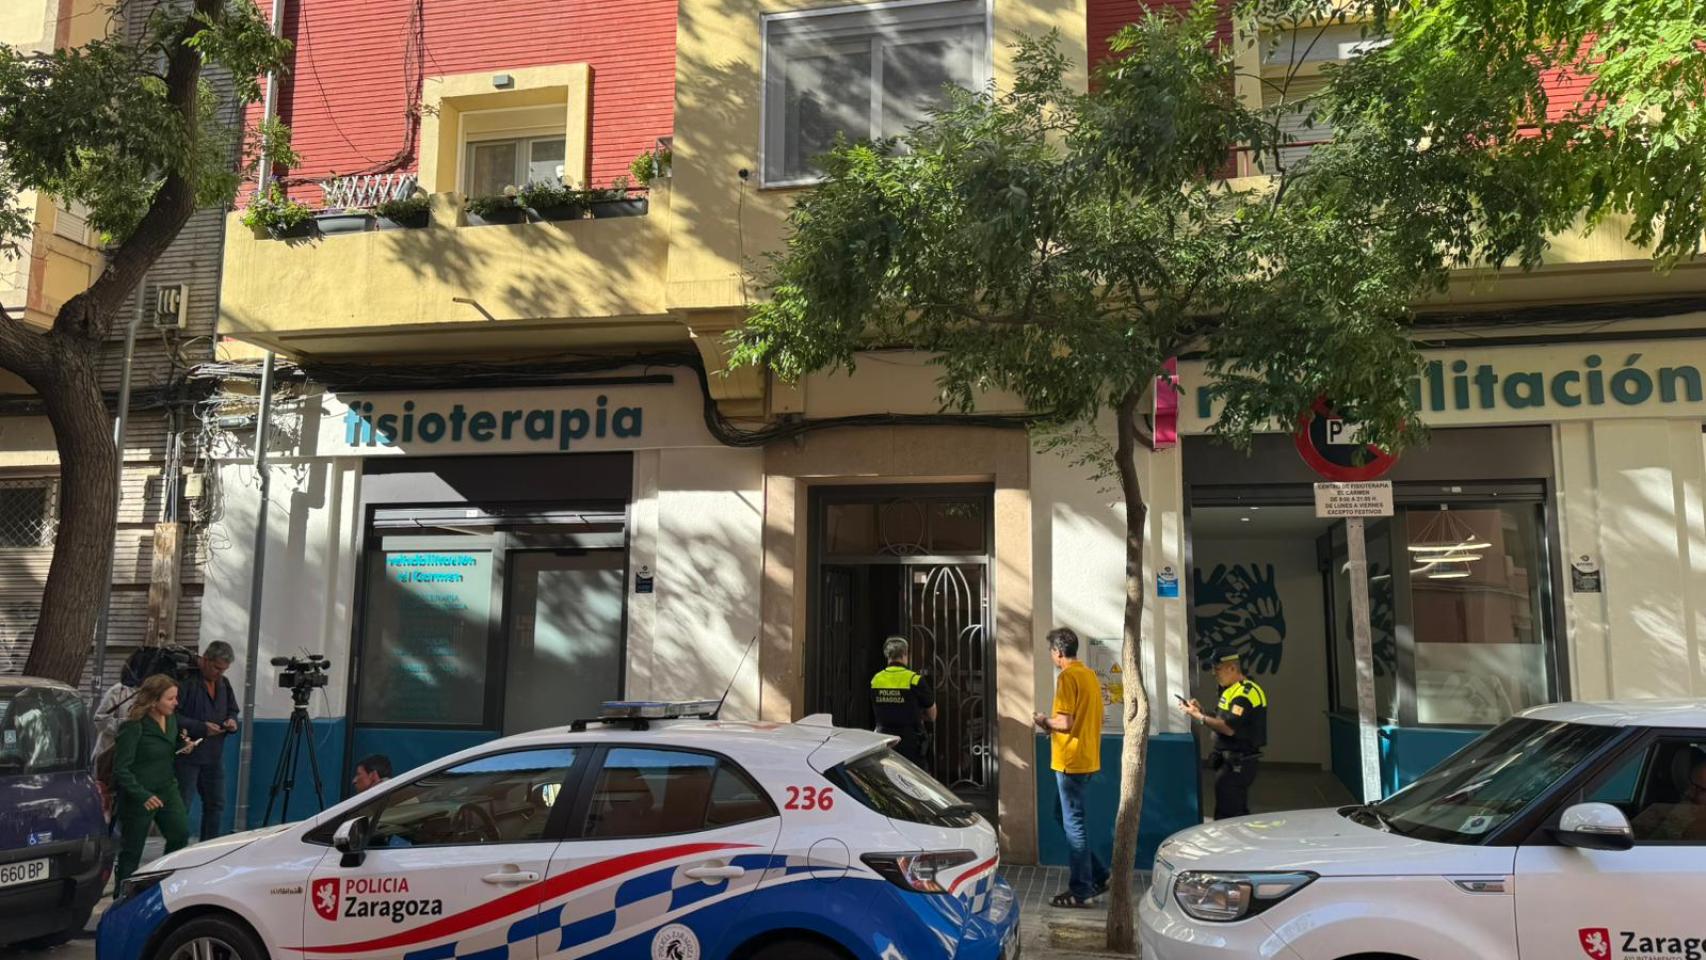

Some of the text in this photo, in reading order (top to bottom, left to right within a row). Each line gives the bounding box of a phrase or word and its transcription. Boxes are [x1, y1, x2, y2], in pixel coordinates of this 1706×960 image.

[344, 394, 643, 450] fisioterapia
[1330, 420, 1343, 442] P
[389, 552, 476, 567] rehabilitación
[414, 571, 463, 583] Carmen
[784, 785, 834, 811] 236
[0, 862, 44, 883] 660 BP
[345, 877, 409, 894] POLICIA
[344, 896, 443, 923] Zaragoza
